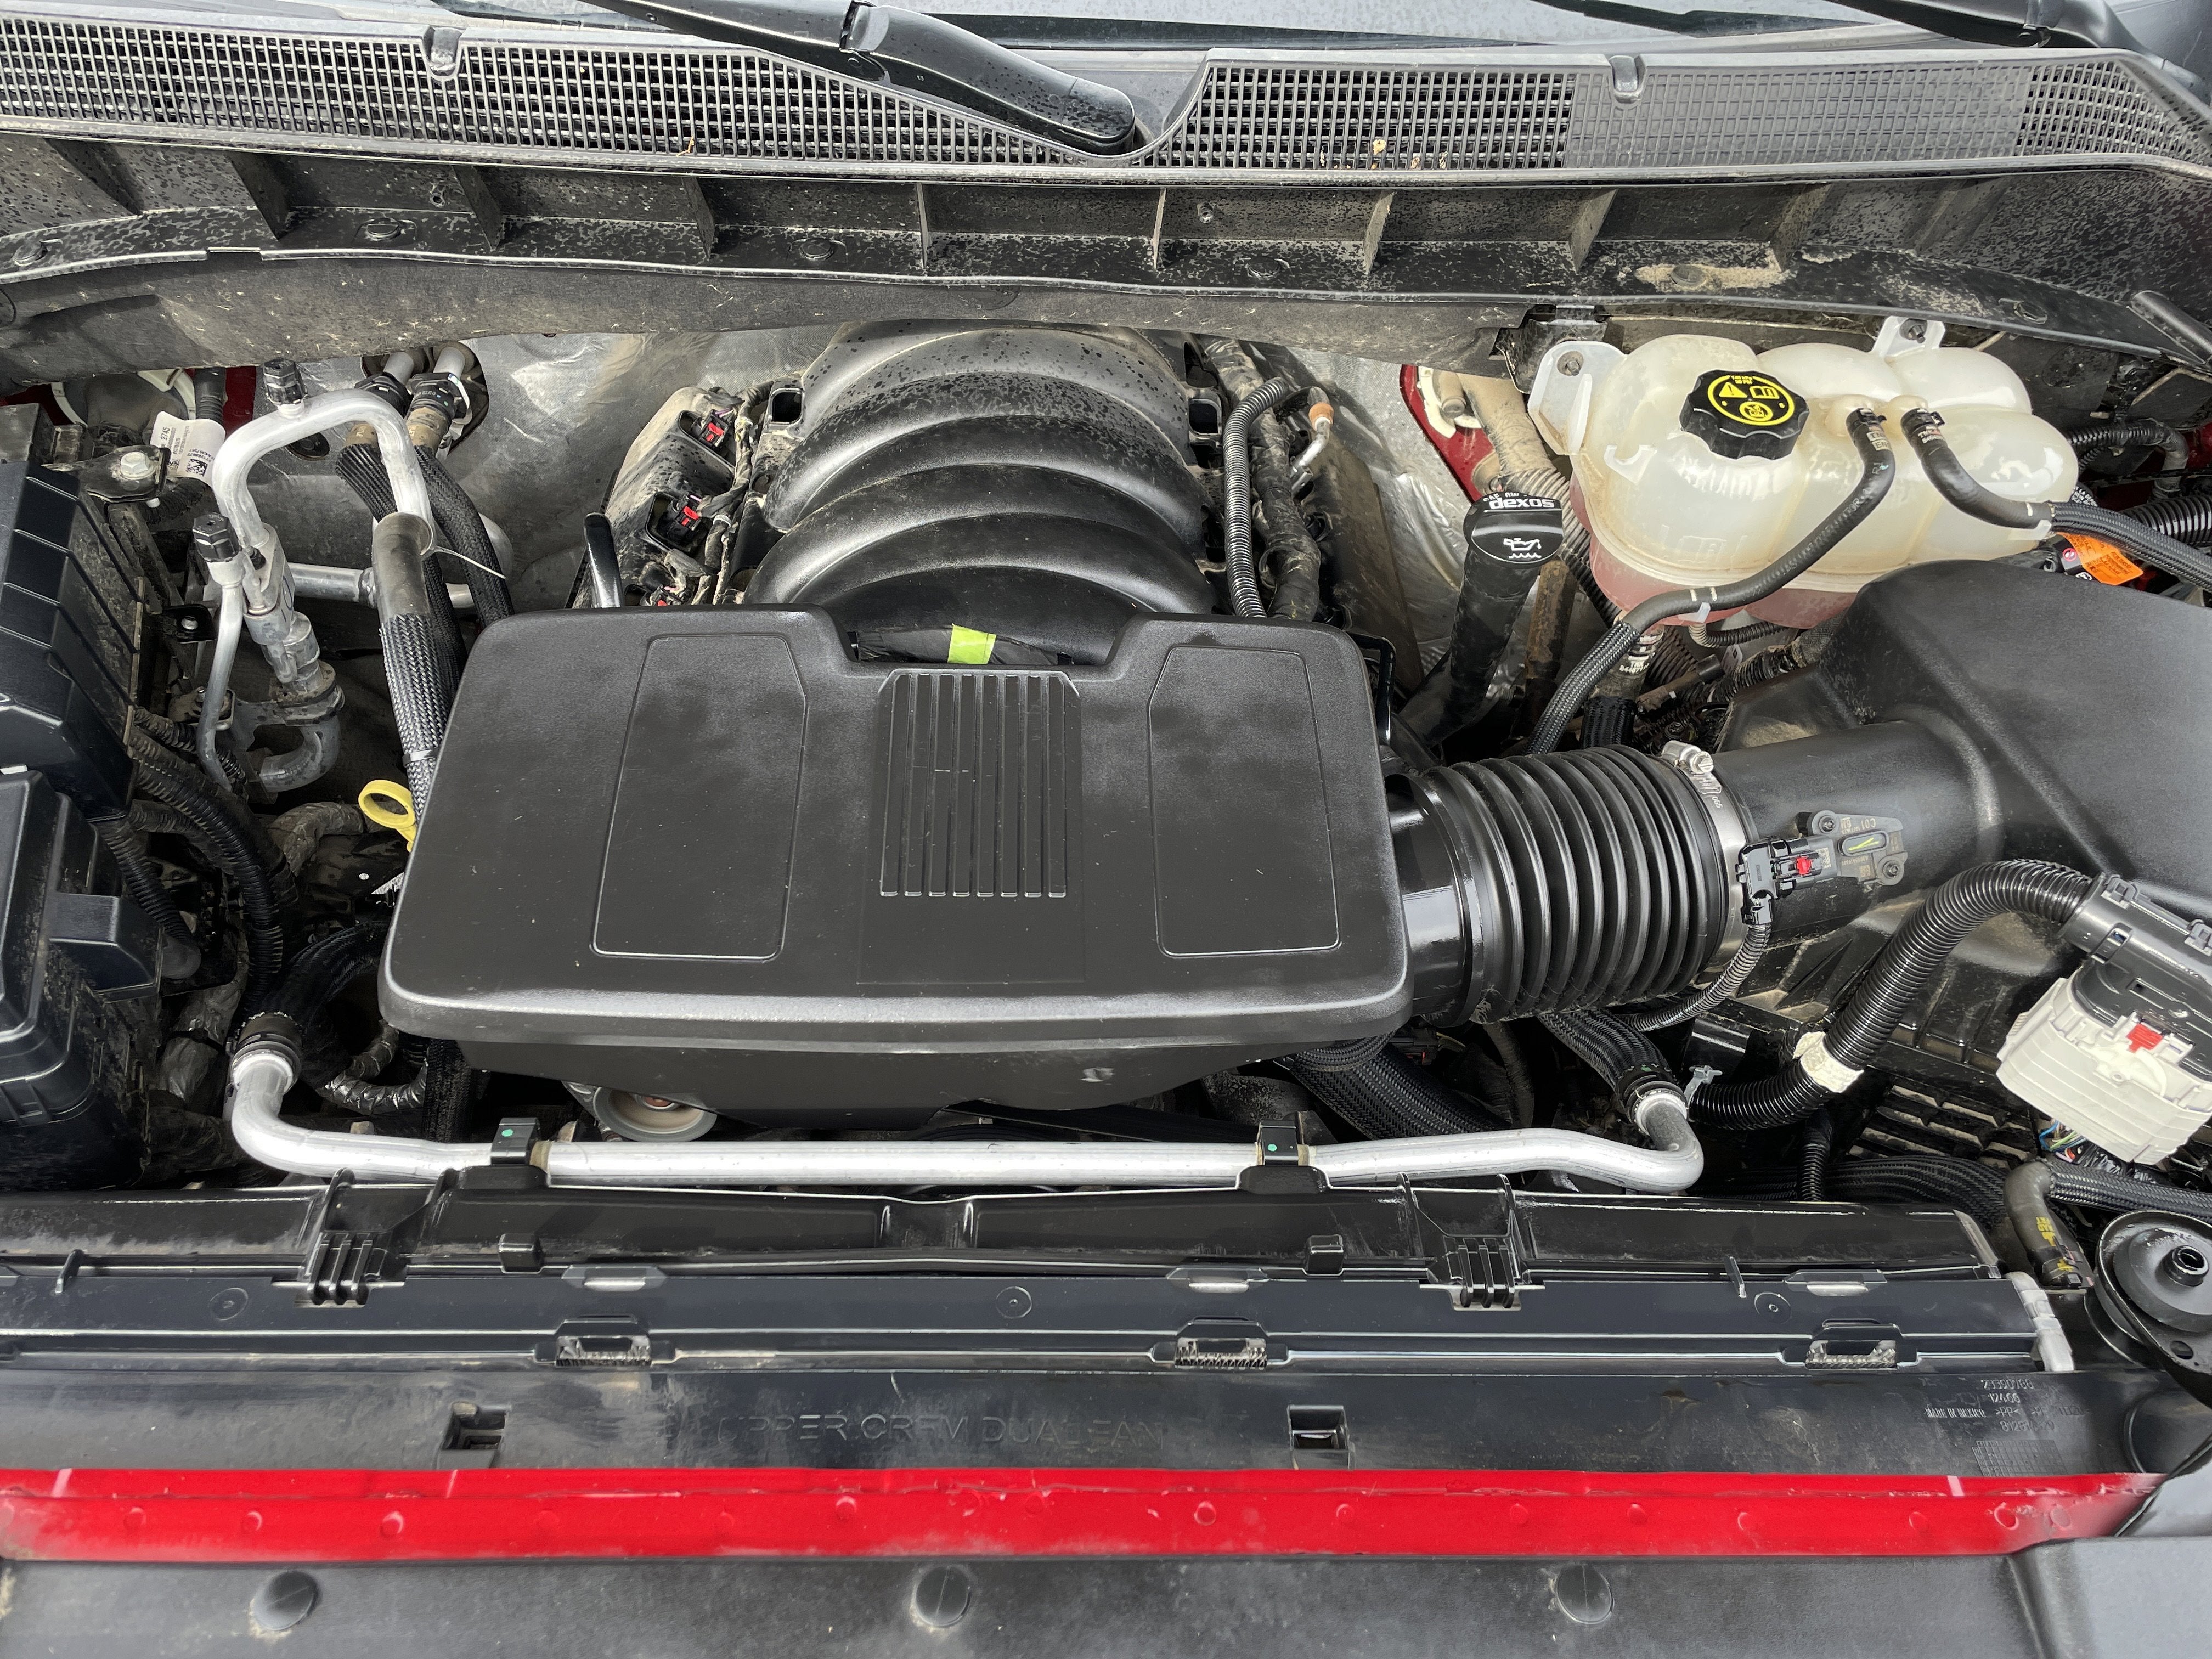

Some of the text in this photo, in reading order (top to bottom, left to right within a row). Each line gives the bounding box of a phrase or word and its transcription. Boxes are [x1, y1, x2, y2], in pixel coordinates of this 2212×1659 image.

[160, 427, 170, 441] 2745
[1489, 497, 1555, 510] dexos
[1925, 1408, 1948, 1418] MADE
[1947, 1408, 1957, 1418] IN
[1956, 1408, 1987, 1418] MEXICO
[718, 1414, 848, 1444] UPPER
